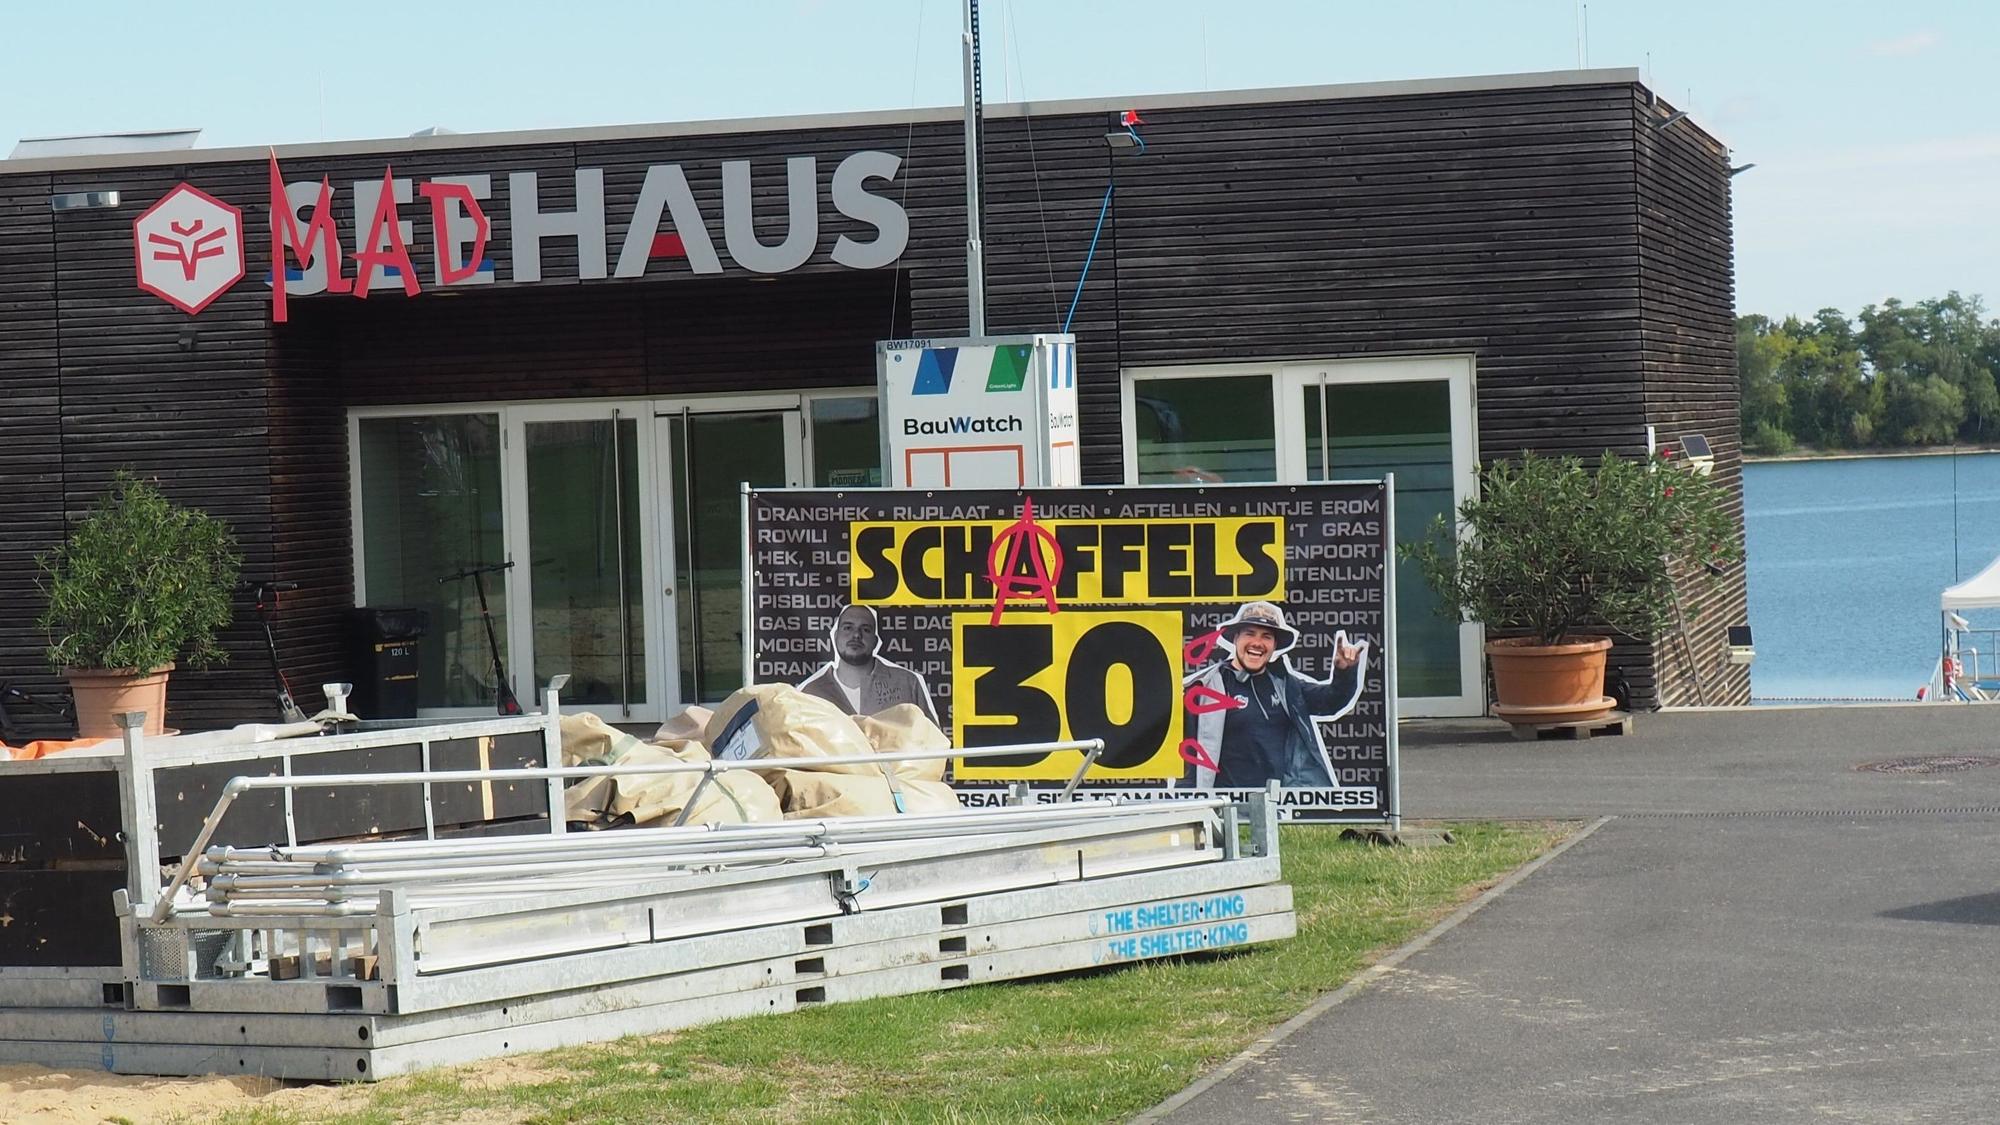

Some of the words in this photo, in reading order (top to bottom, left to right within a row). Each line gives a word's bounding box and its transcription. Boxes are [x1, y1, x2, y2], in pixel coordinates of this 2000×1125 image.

[269, 145, 489, 322] MAD
[886, 340, 932, 350] BW17091
[904, 415, 1023, 435] BauWatch
[757, 507, 869, 522] DRANGHEK
[893, 505, 989, 520] RIJPLAAT
[1013, 504, 1095, 519] BEUKEN
[1119, 502, 1221, 518] AFTELLEN
[1245, 501, 1313, 516] LINTJE
[1321, 499, 1380, 515] EROM
[758, 529, 827, 543] ROWILI
[1322, 521, 1380, 537] GRAS
[758, 551, 804, 568] HEK,
[856, 521, 1279, 600] SCHAFFELS
[759, 594, 845, 609] PISBLOK
[760, 616, 801, 631] GAS
[808, 616, 838, 631] ER
[882, 616, 907, 630] 1E
[760, 638, 832, 652] MOGEN
[887, 638, 913, 652] AL
[760, 661, 828, 676] DRAN
[963, 621, 1174, 769] 30
[1319, 724, 1383, 738] NLIJN
[1037, 793, 1084, 804] SIE
[1277, 791, 1374, 806] ADNESS
[1105, 912, 1134, 933] THE
[1137, 901, 1200, 927] SHELTER
[1204, 894, 1245, 918] KING
[1109, 939, 1137, 958] THE
[1140, 930, 1203, 957] SHELTER
[1207, 922, 1248, 947] KING
